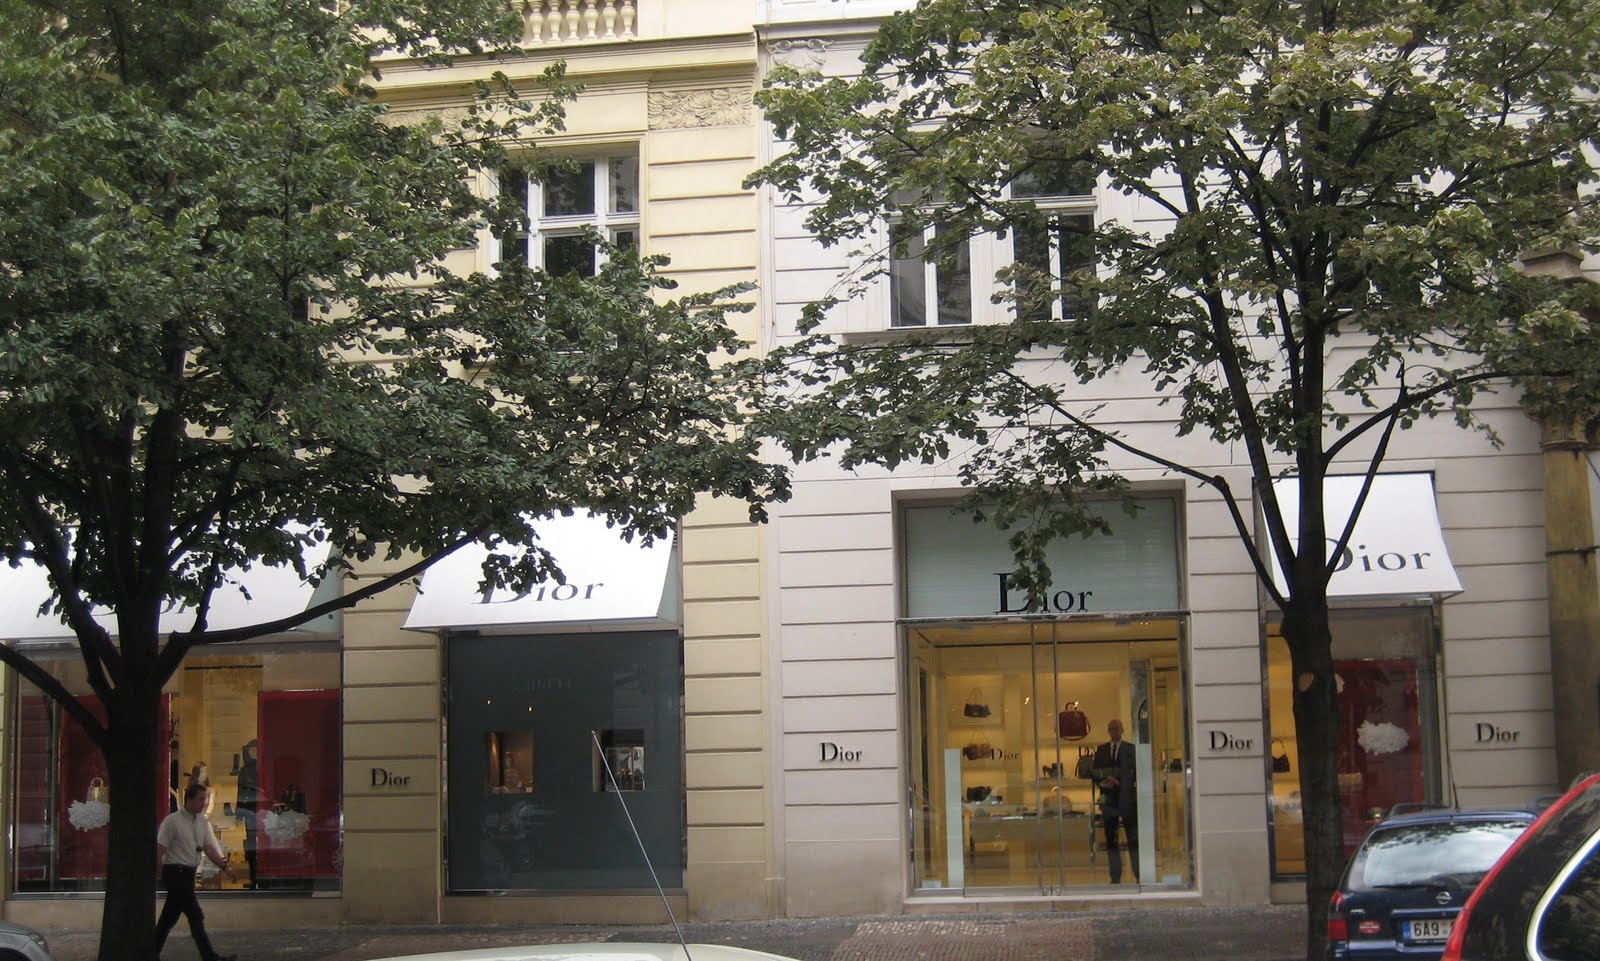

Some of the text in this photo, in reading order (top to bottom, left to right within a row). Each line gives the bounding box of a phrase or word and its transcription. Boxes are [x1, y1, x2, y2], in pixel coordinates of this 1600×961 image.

[1209, 730, 1253, 750] Dior
[1474, 722, 1520, 743] Dior
[819, 742, 863, 761] Dior
[990, 747, 1020, 761] Dior
[370, 767, 411, 786] Dior
[1413, 921, 1440, 938] 6A9
